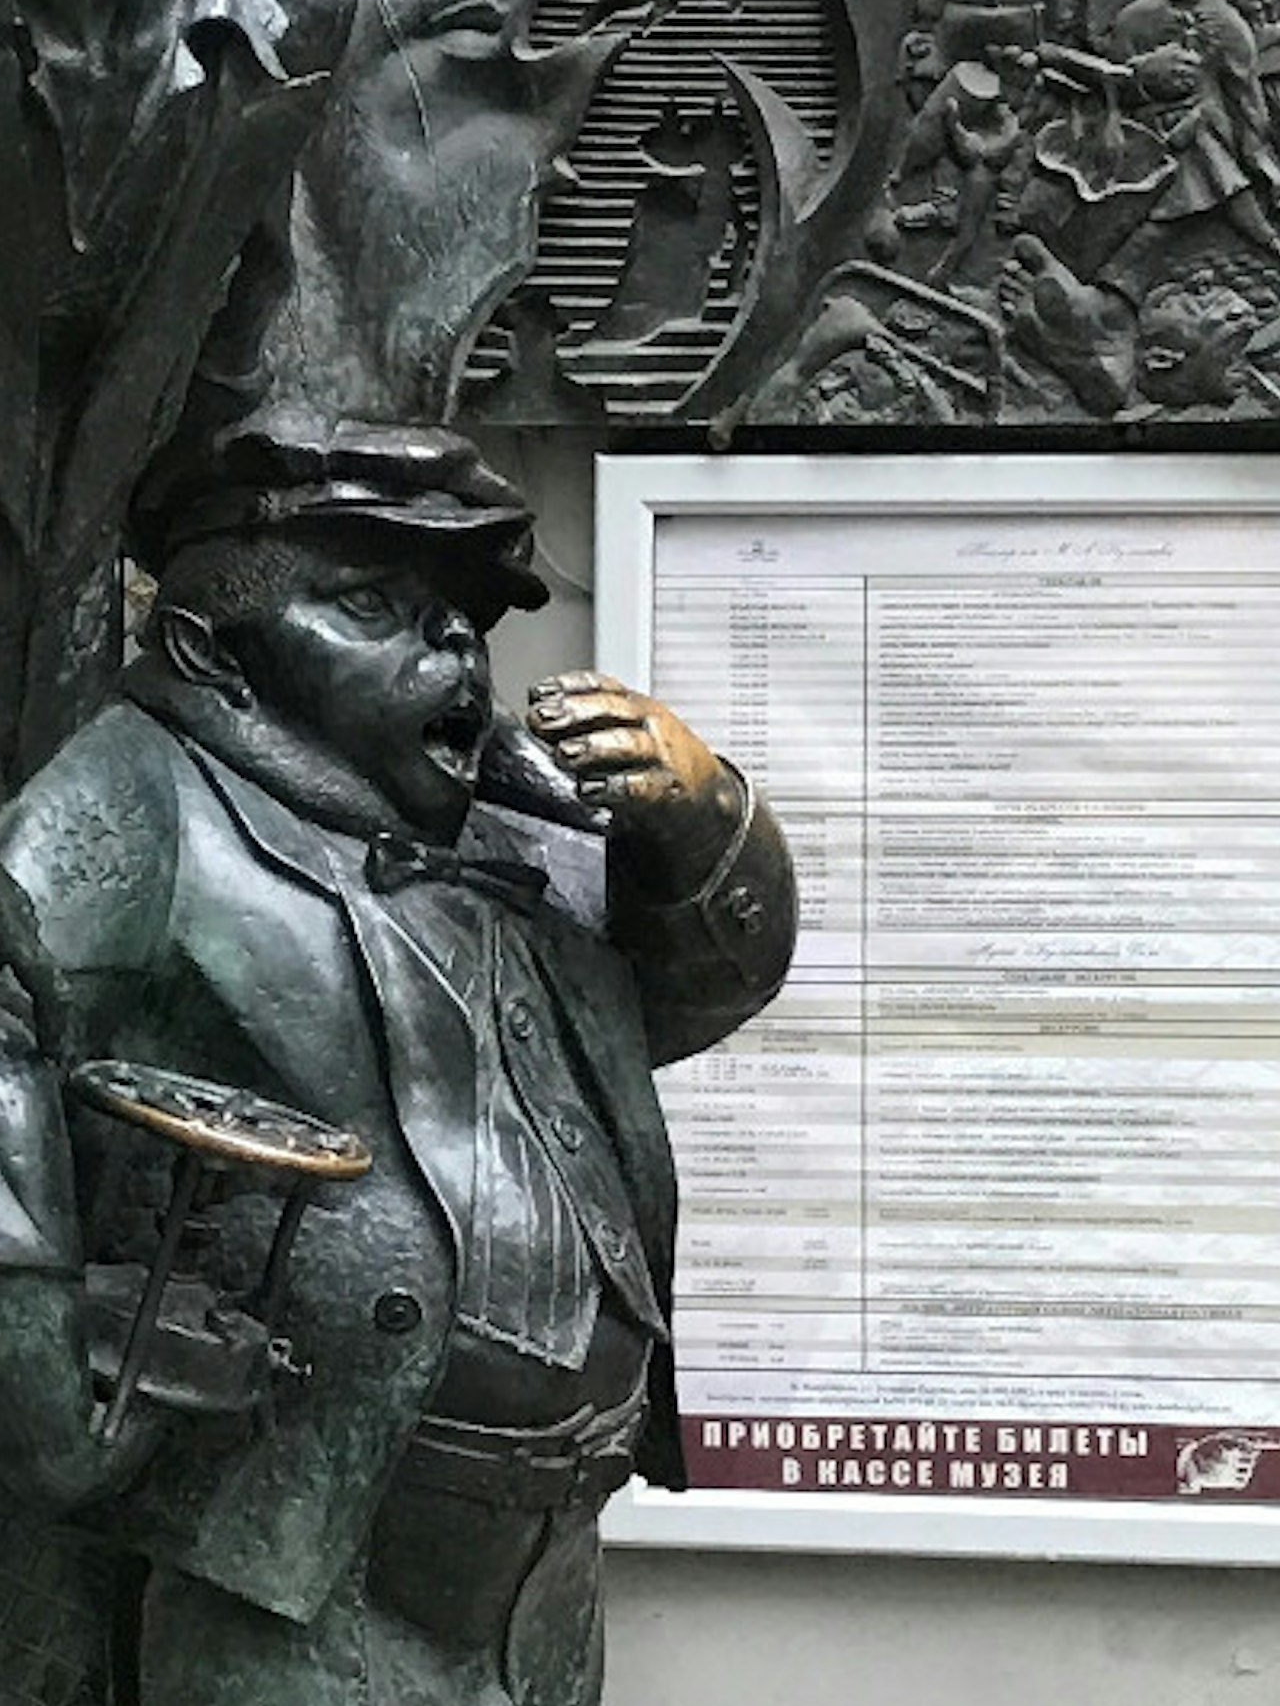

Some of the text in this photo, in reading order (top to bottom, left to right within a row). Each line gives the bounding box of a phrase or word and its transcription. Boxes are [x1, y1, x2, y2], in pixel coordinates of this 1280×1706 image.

[701, 1419, 1149, 1457] ПРИОБРЕТАЙТЕ БИЛЕТЫ
[781, 1457, 1070, 1490] В КАССЕ МУЗЕЯ
